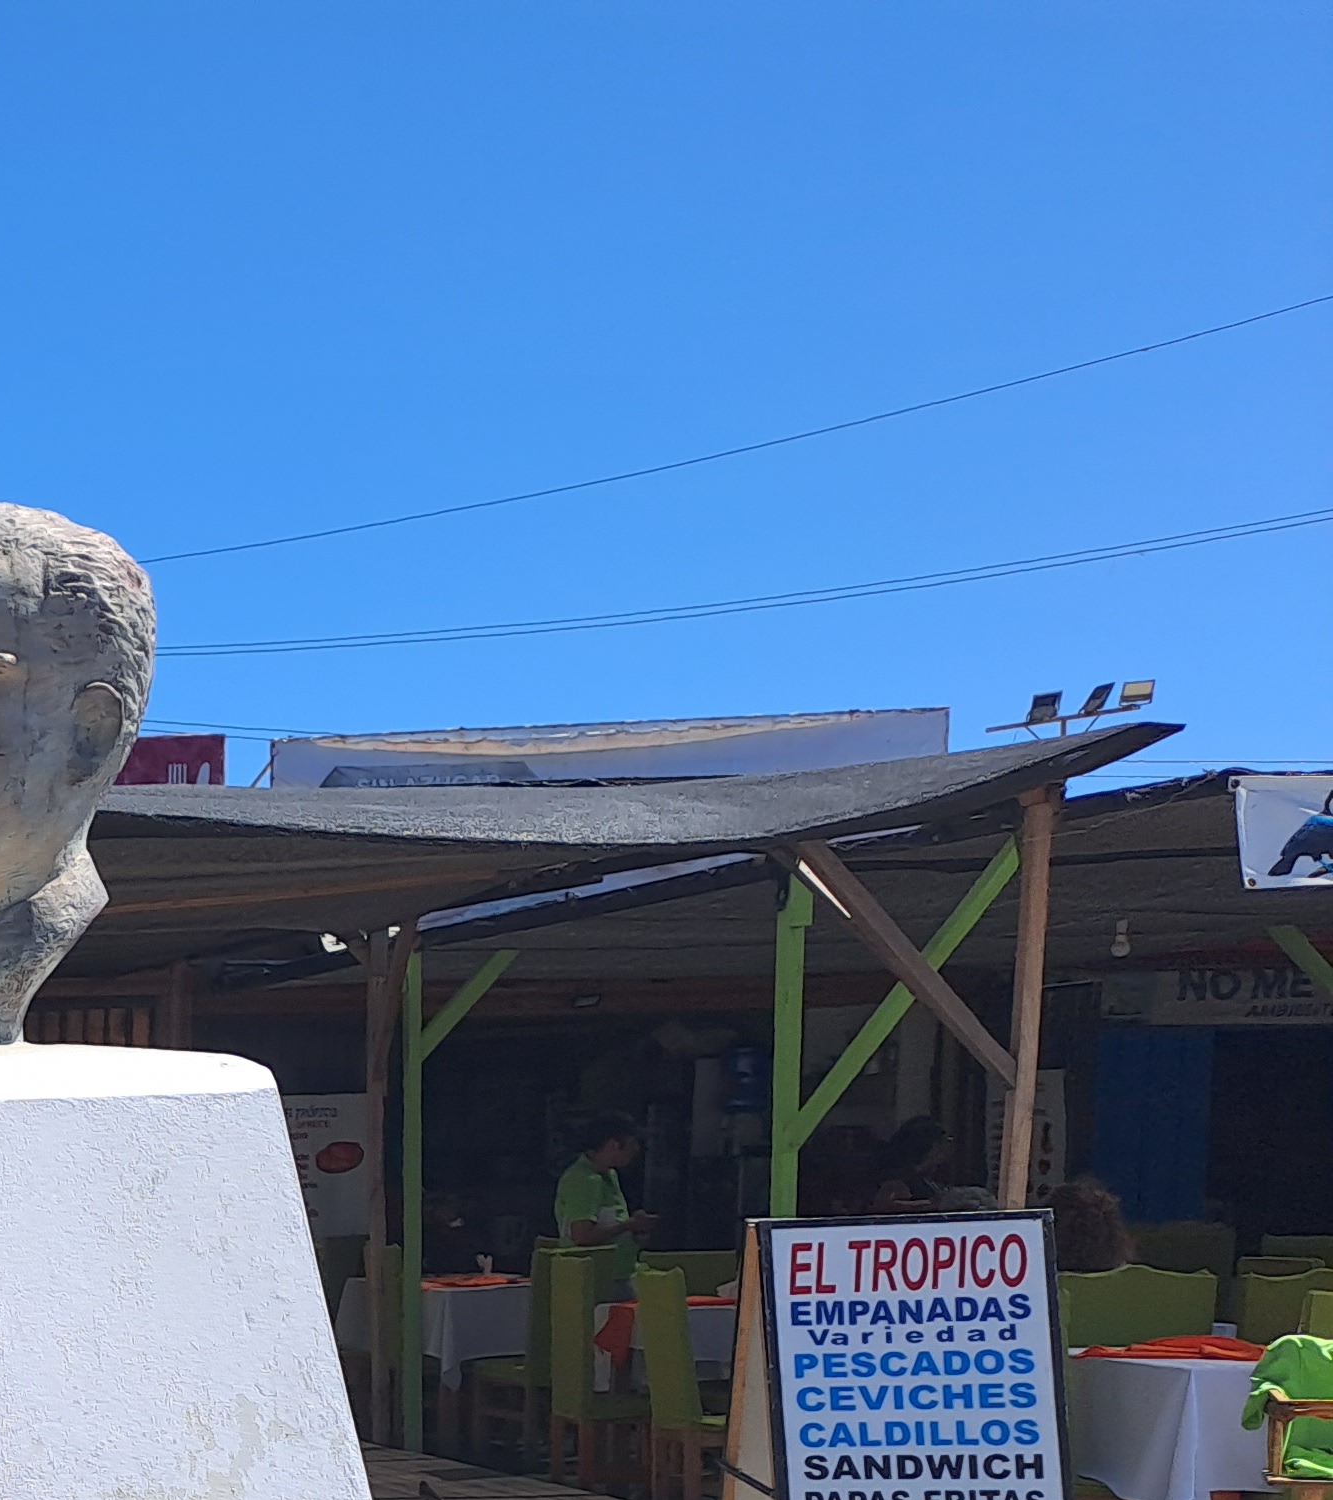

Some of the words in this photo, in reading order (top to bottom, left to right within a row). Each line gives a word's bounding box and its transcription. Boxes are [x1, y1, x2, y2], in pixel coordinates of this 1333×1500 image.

[790, 1241, 837, 1295] EL
[848, 1233, 1028, 1293] TROPICO
[790, 1293, 1032, 1326] EMPANADAS
[807, 1323, 1017, 1346] Variedad
[793, 1348, 1035, 1379] PESCADOS
[796, 1382, 1037, 1412] CEVICHES
[799, 1419, 1040, 1448] CALDILLOS
[803, 1454, 1044, 1480] SANDWICH
